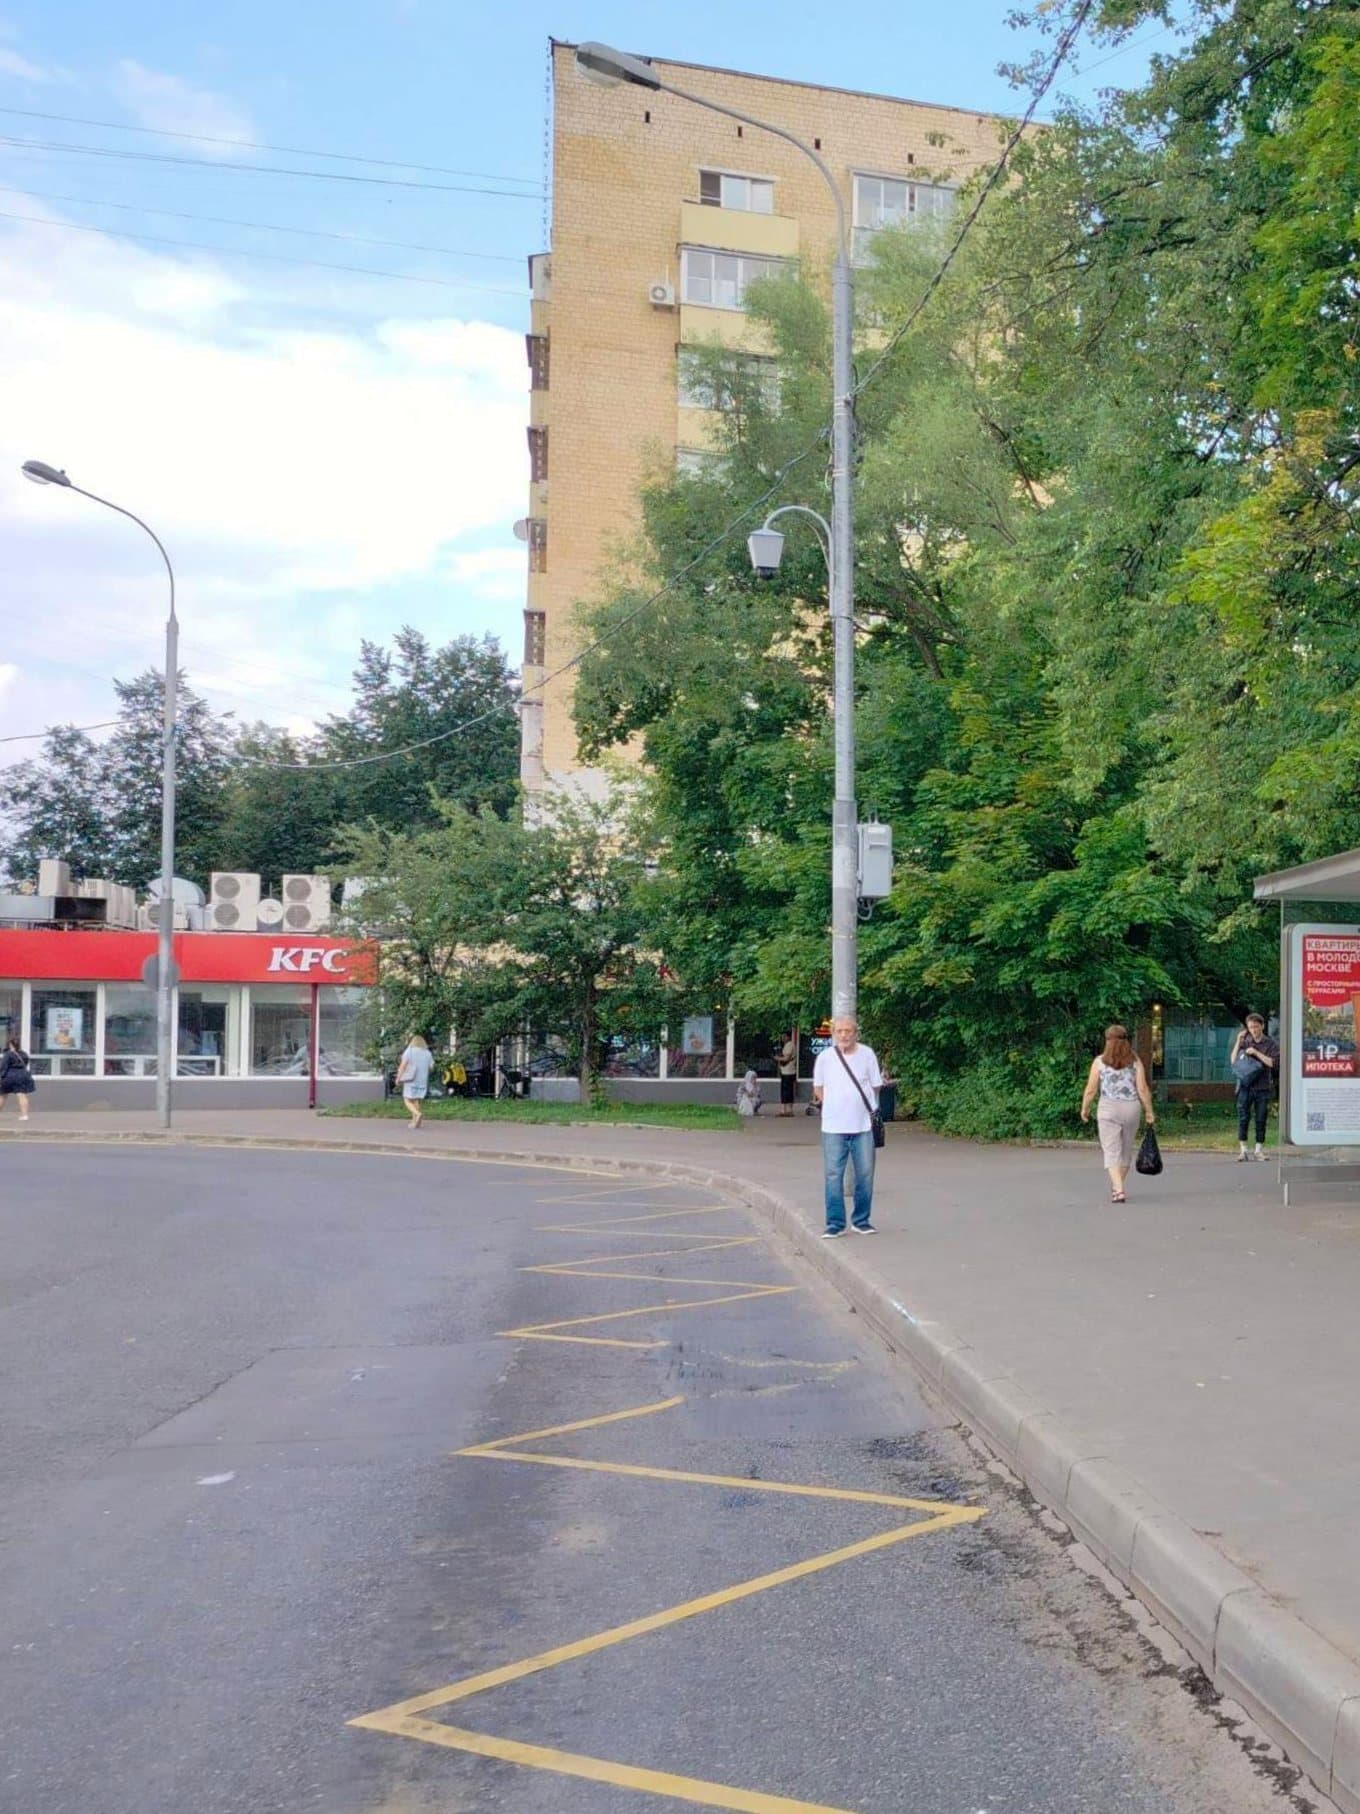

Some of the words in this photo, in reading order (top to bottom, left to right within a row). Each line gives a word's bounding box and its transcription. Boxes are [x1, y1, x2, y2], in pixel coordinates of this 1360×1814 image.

[266, 946, 348, 972] KFC
[1307, 952, 1315, 962] В
[1307, 963, 1352, 973] МОСКВЕ
[1305, 1061, 1354, 1071] ИПОТЕКА
